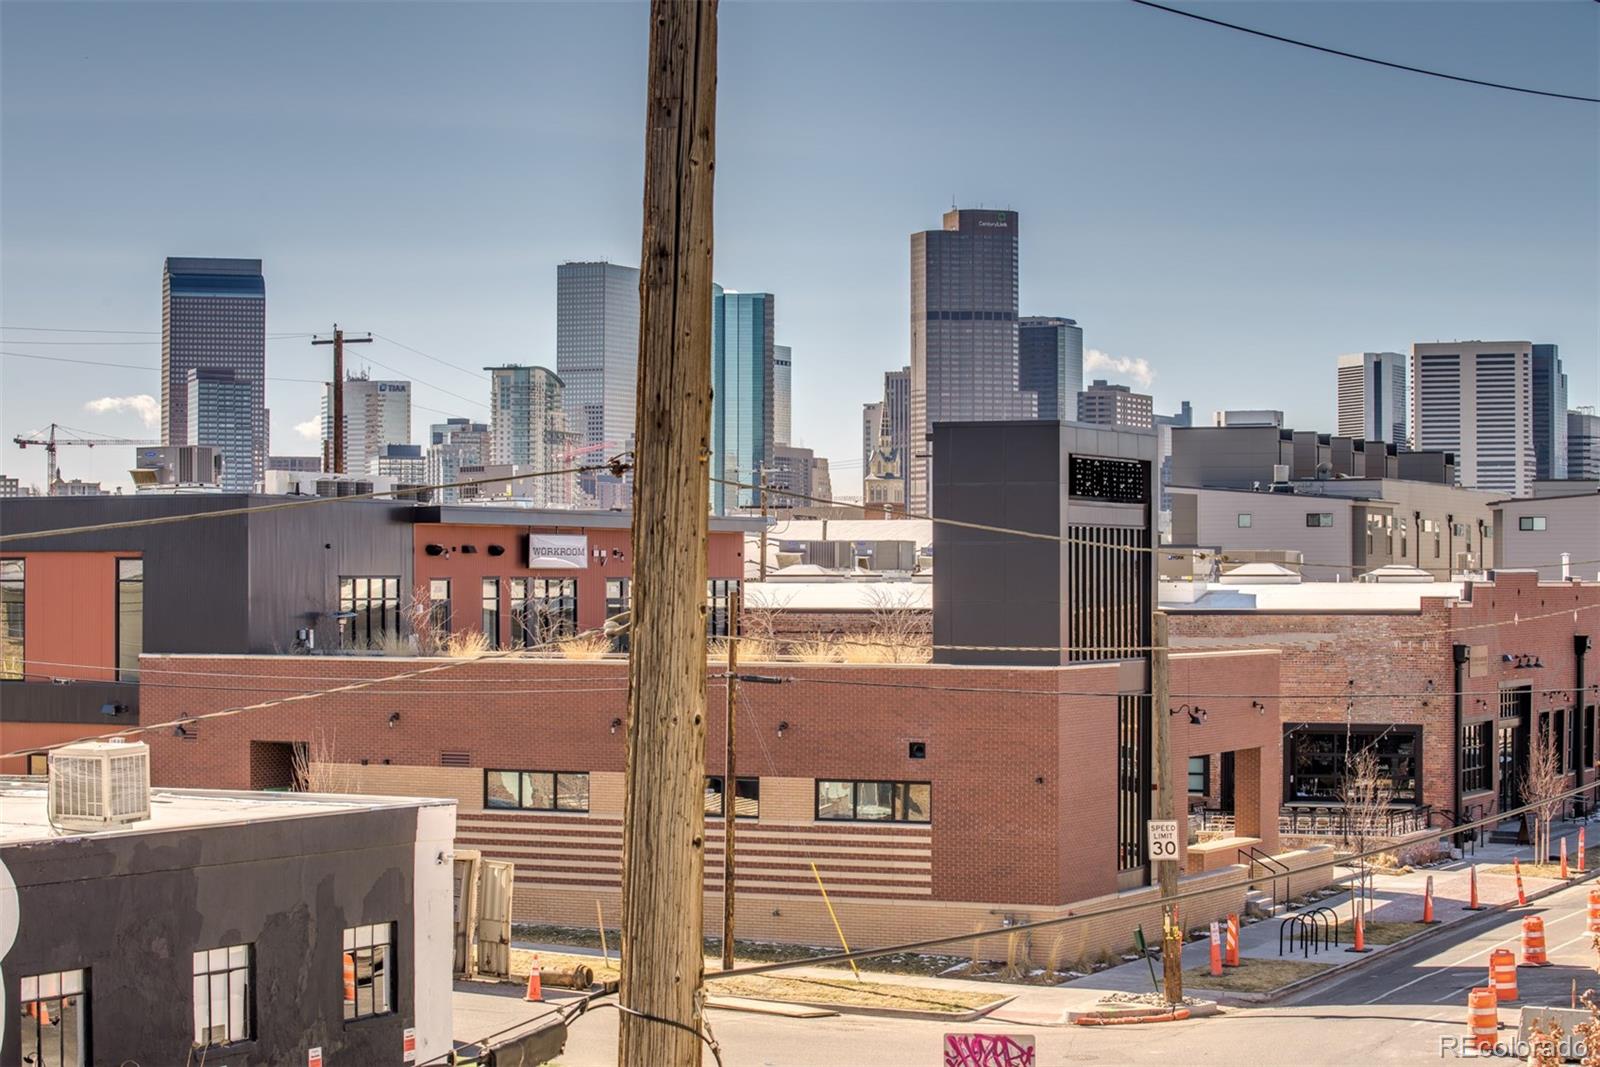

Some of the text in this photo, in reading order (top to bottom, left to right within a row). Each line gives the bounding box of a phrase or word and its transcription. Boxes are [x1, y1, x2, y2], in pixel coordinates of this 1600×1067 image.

[388, 384, 406, 393] TIAA
[532, 546, 585, 557] WORKROOM
[1150, 824, 1176, 832] SPEED
[1153, 832, 1173, 840] LIMIT
[1153, 841, 1176, 856] 30
